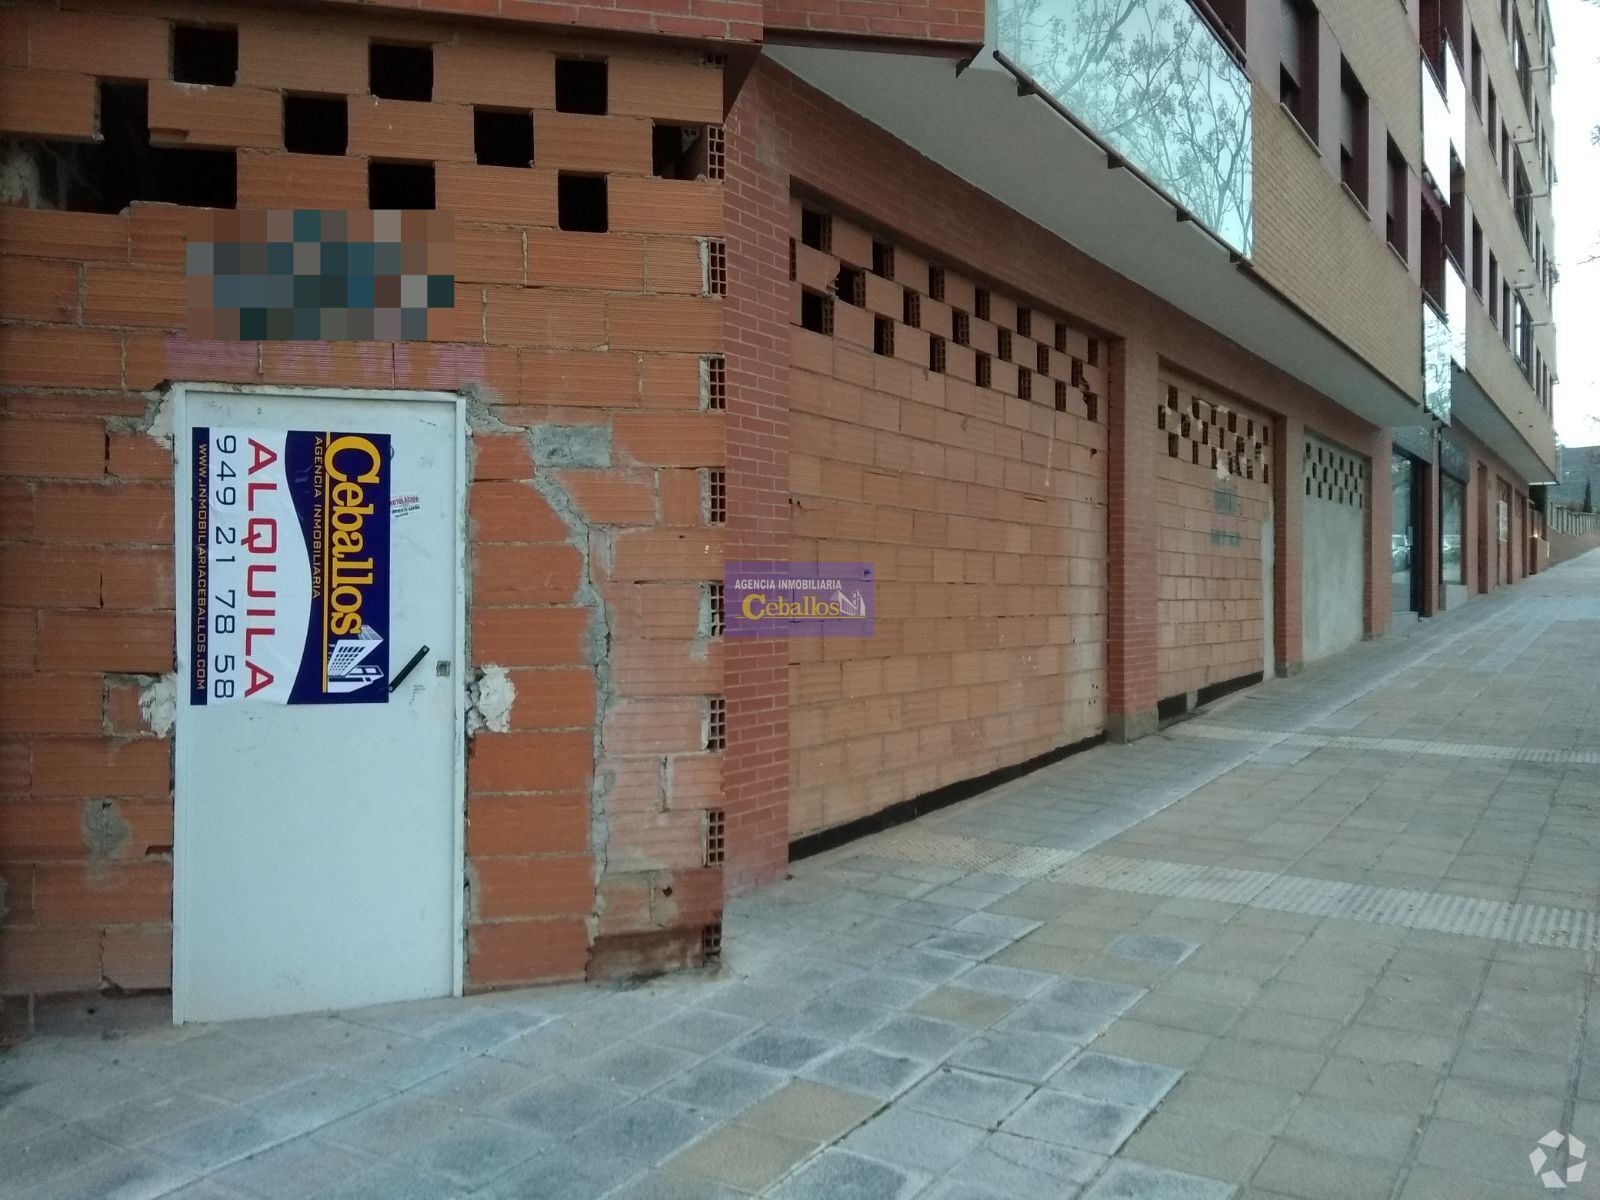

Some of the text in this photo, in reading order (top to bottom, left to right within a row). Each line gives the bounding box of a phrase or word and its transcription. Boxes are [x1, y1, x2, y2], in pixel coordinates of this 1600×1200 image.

[196, 443, 208, 690] WWW.INMOBILIARIACEBALLOS.COM
[214, 435, 237, 699] 949 21 78 58
[241, 437, 278, 698] ALQUILA
[312, 436, 323, 599] AGENCIA INMOBILIARIA
[324, 435, 381, 635] Ceballos
